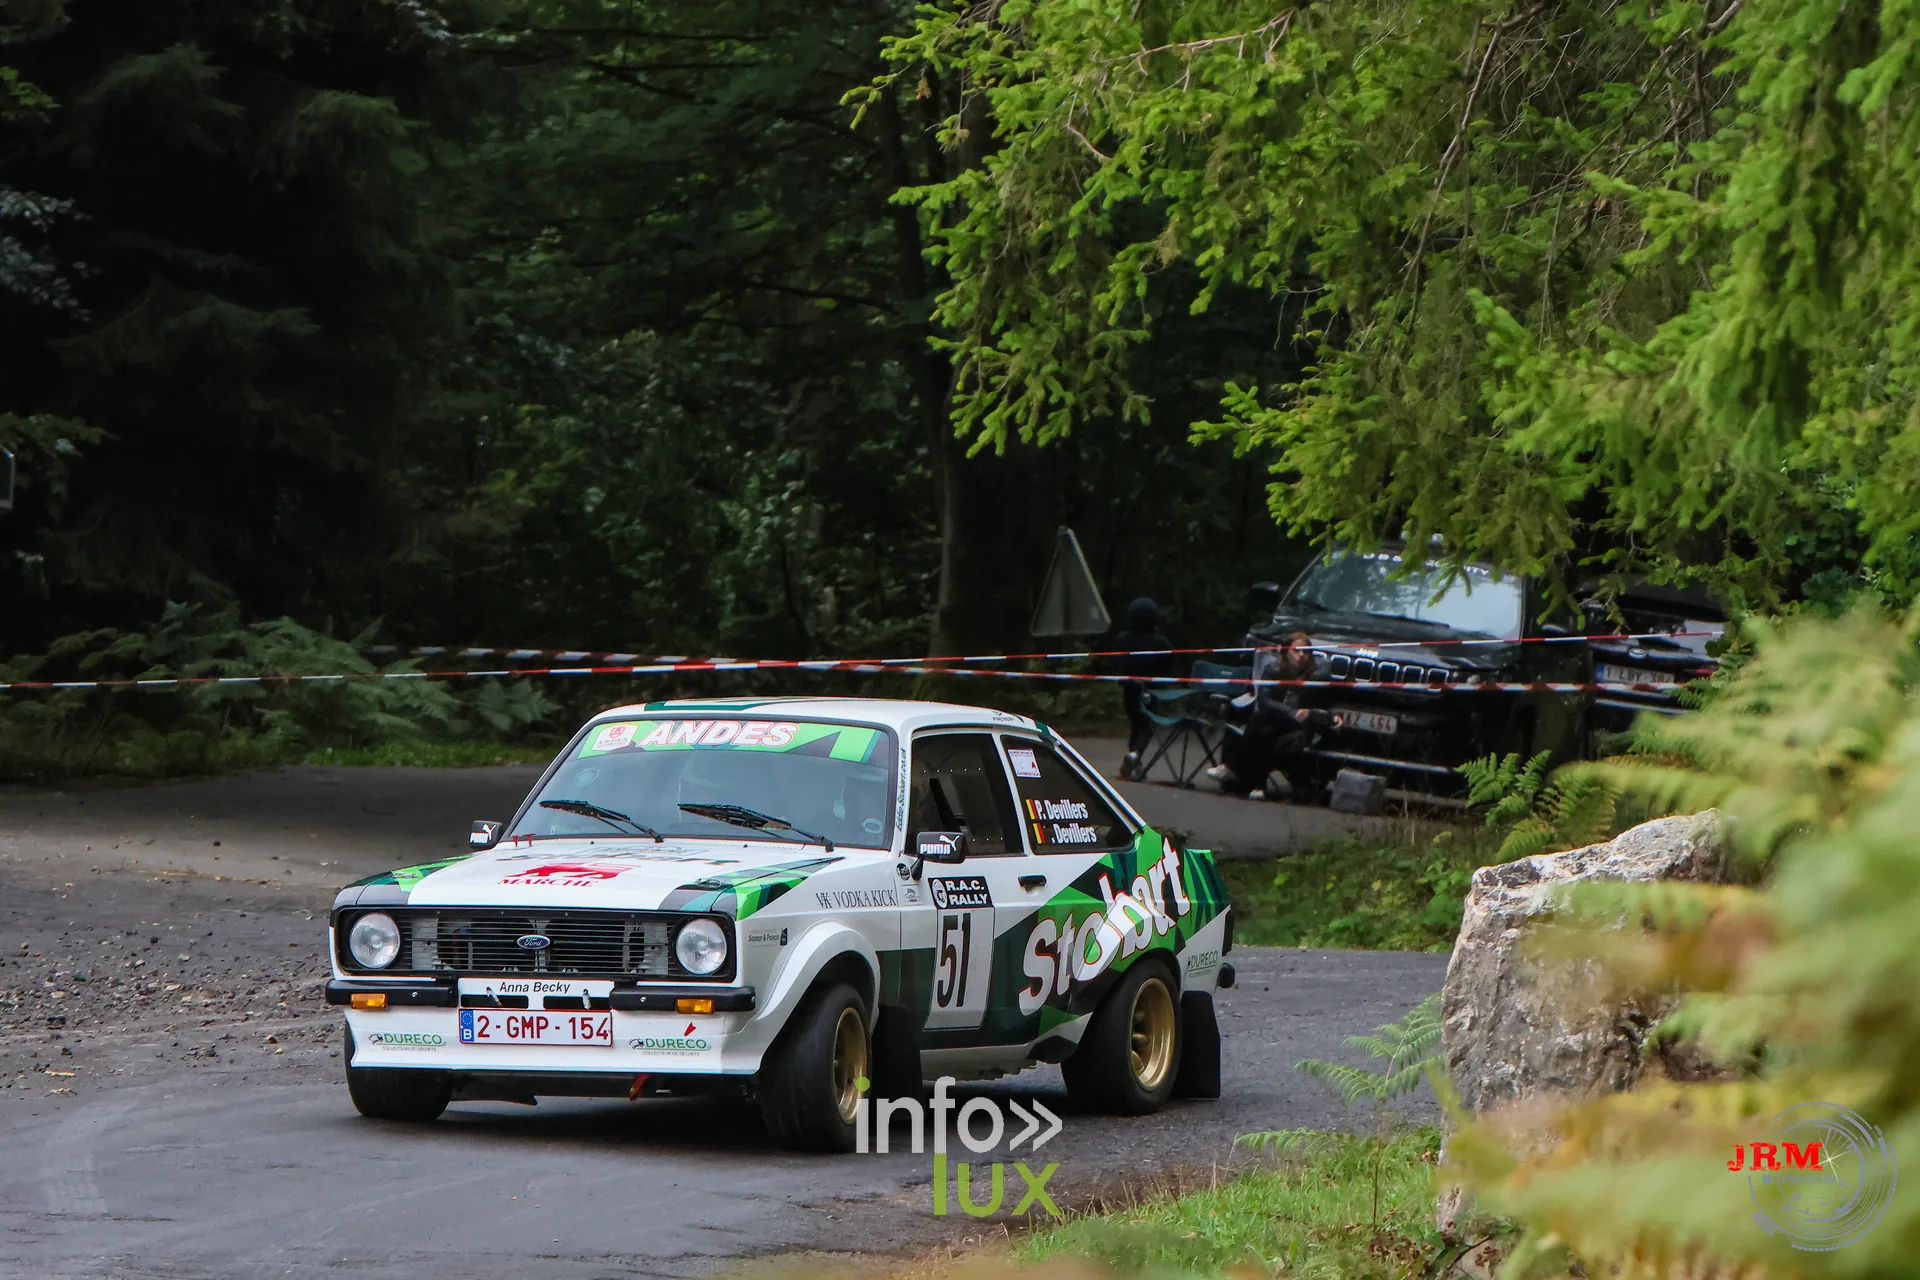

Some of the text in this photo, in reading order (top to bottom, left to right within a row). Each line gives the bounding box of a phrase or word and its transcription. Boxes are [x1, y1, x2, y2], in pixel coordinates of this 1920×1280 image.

[634, 720, 799, 748] ANDES
[1034, 798, 1089, 820] P. Devillers
[1053, 822, 1097, 844] Devillers
[920, 843, 951, 855] PUMA
[497, 878, 600, 888] MARCHE
[945, 880, 985, 892] R.A.C.
[832, 890, 872, 908] VODKA
[872, 889, 897, 907] KICK
[949, 893, 988, 906] RALLY
[523, 938, 543, 947] Ford
[937, 912, 971, 1008] 51
[499, 982, 571, 995] Anna Becky
[384, 1033, 442, 1045] DURECO
[462, 1028, 472, 1040] B
[645, 1038, 707, 1049] DURECO
